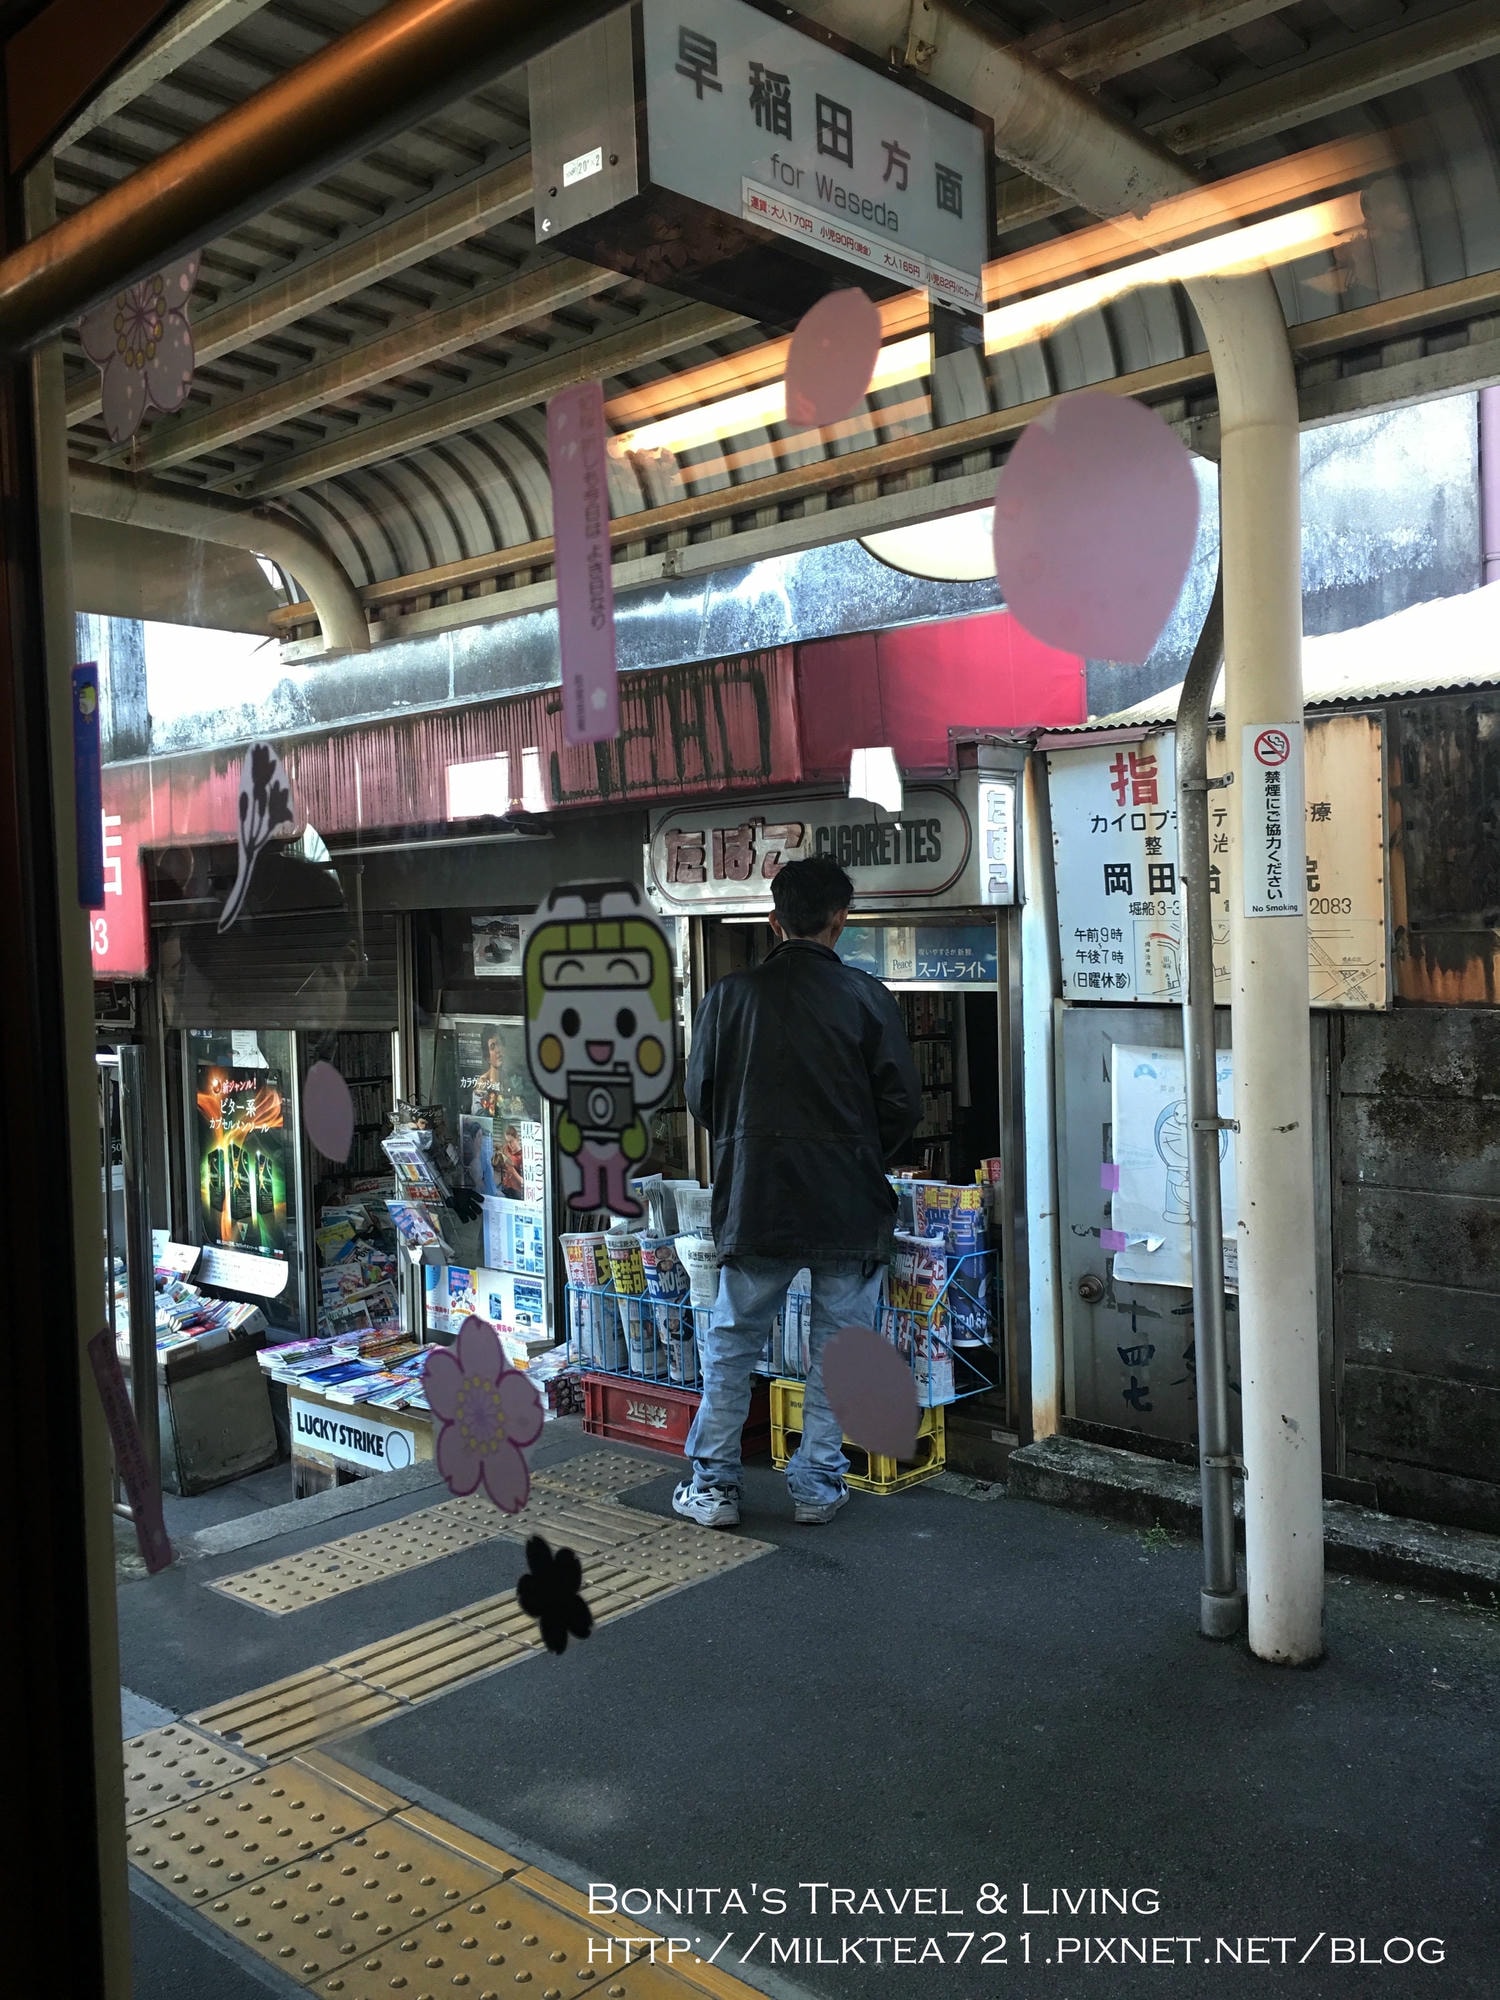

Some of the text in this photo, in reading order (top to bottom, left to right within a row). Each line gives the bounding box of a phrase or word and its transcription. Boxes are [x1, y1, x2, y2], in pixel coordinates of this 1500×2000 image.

[675, 25, 963, 219] 早稲田方面
[770, 153, 899, 232] for Waseda
[883, 252, 921, 278] 大人165円
[1109, 751, 1159, 807] 指
[815, 817, 942, 867] CIGARETTES
[987, 790, 1009, 894] たばこ
[1145, 836, 1163, 856] 整
[1264, 770, 1284, 901] 禁煙にご協力ください
[664, 816, 806, 884] たばこ
[1252, 903, 1298, 913] No Smoking
[1309, 897, 1352, 915] 2083
[1074, 927, 1124, 943] 午前9時
[892, 958, 913, 971] Peace
[1075, 949, 1124, 965] 午後7時
[918, 961, 987, 978] スーパーライト
[1072, 972, 1131, 990] (日曜休診)
[220, 1098, 257, 1118] ビター系
[297, 1411, 385, 1458] LUCKY STRIKE
